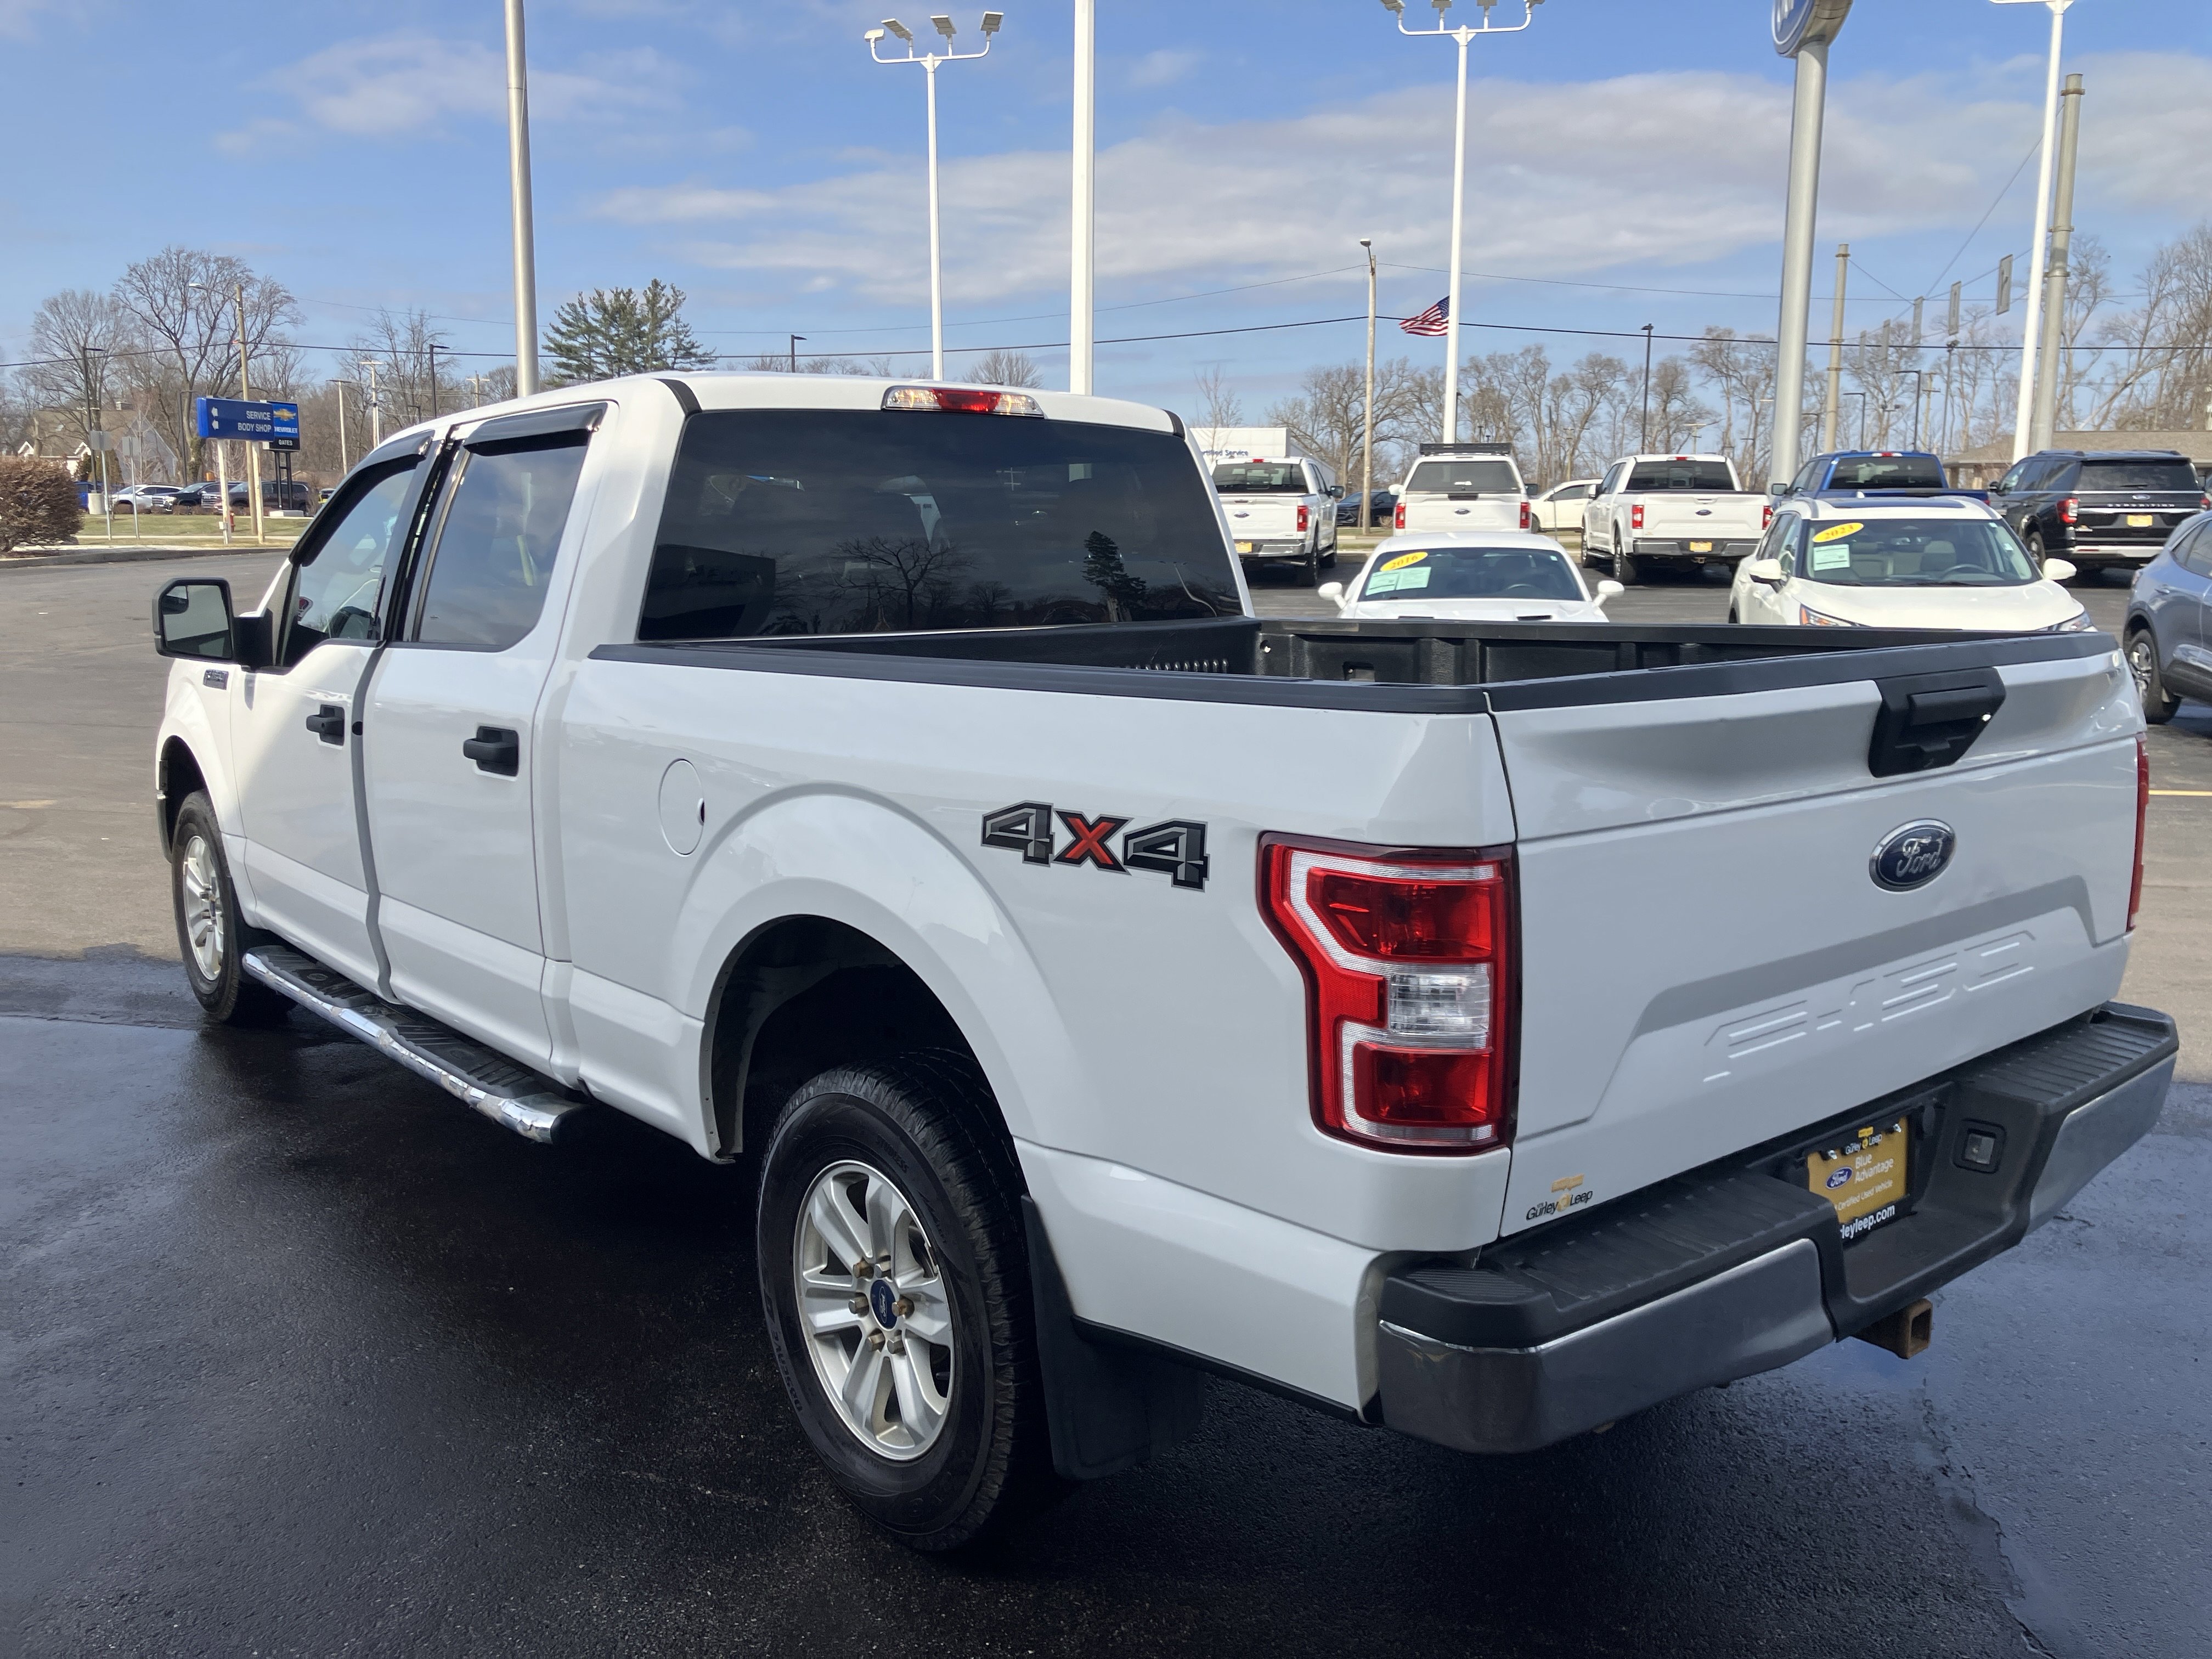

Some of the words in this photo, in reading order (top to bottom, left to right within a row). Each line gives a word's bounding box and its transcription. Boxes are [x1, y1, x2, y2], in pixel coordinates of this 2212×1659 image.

[246, 410, 272, 421] SERVICE
[238, 422, 255, 431] BODY
[256, 424, 272, 433] SHOP
[1825, 524, 1854, 540] 2023
[1391, 555, 1418, 569] 2016
[1895, 836, 1944, 878] Ford
[1703, 930, 2036, 1082] F-150
[1869, 1133, 1882, 1146] Leep
[1855, 1154, 1872, 1170] Blue
[1855, 1158, 1894, 1183] Advantage
[1830, 1170, 1849, 1188] Ford
[1526, 1201, 1559, 1220] Gurley
[1570, 1190, 1593, 1206] Leep
